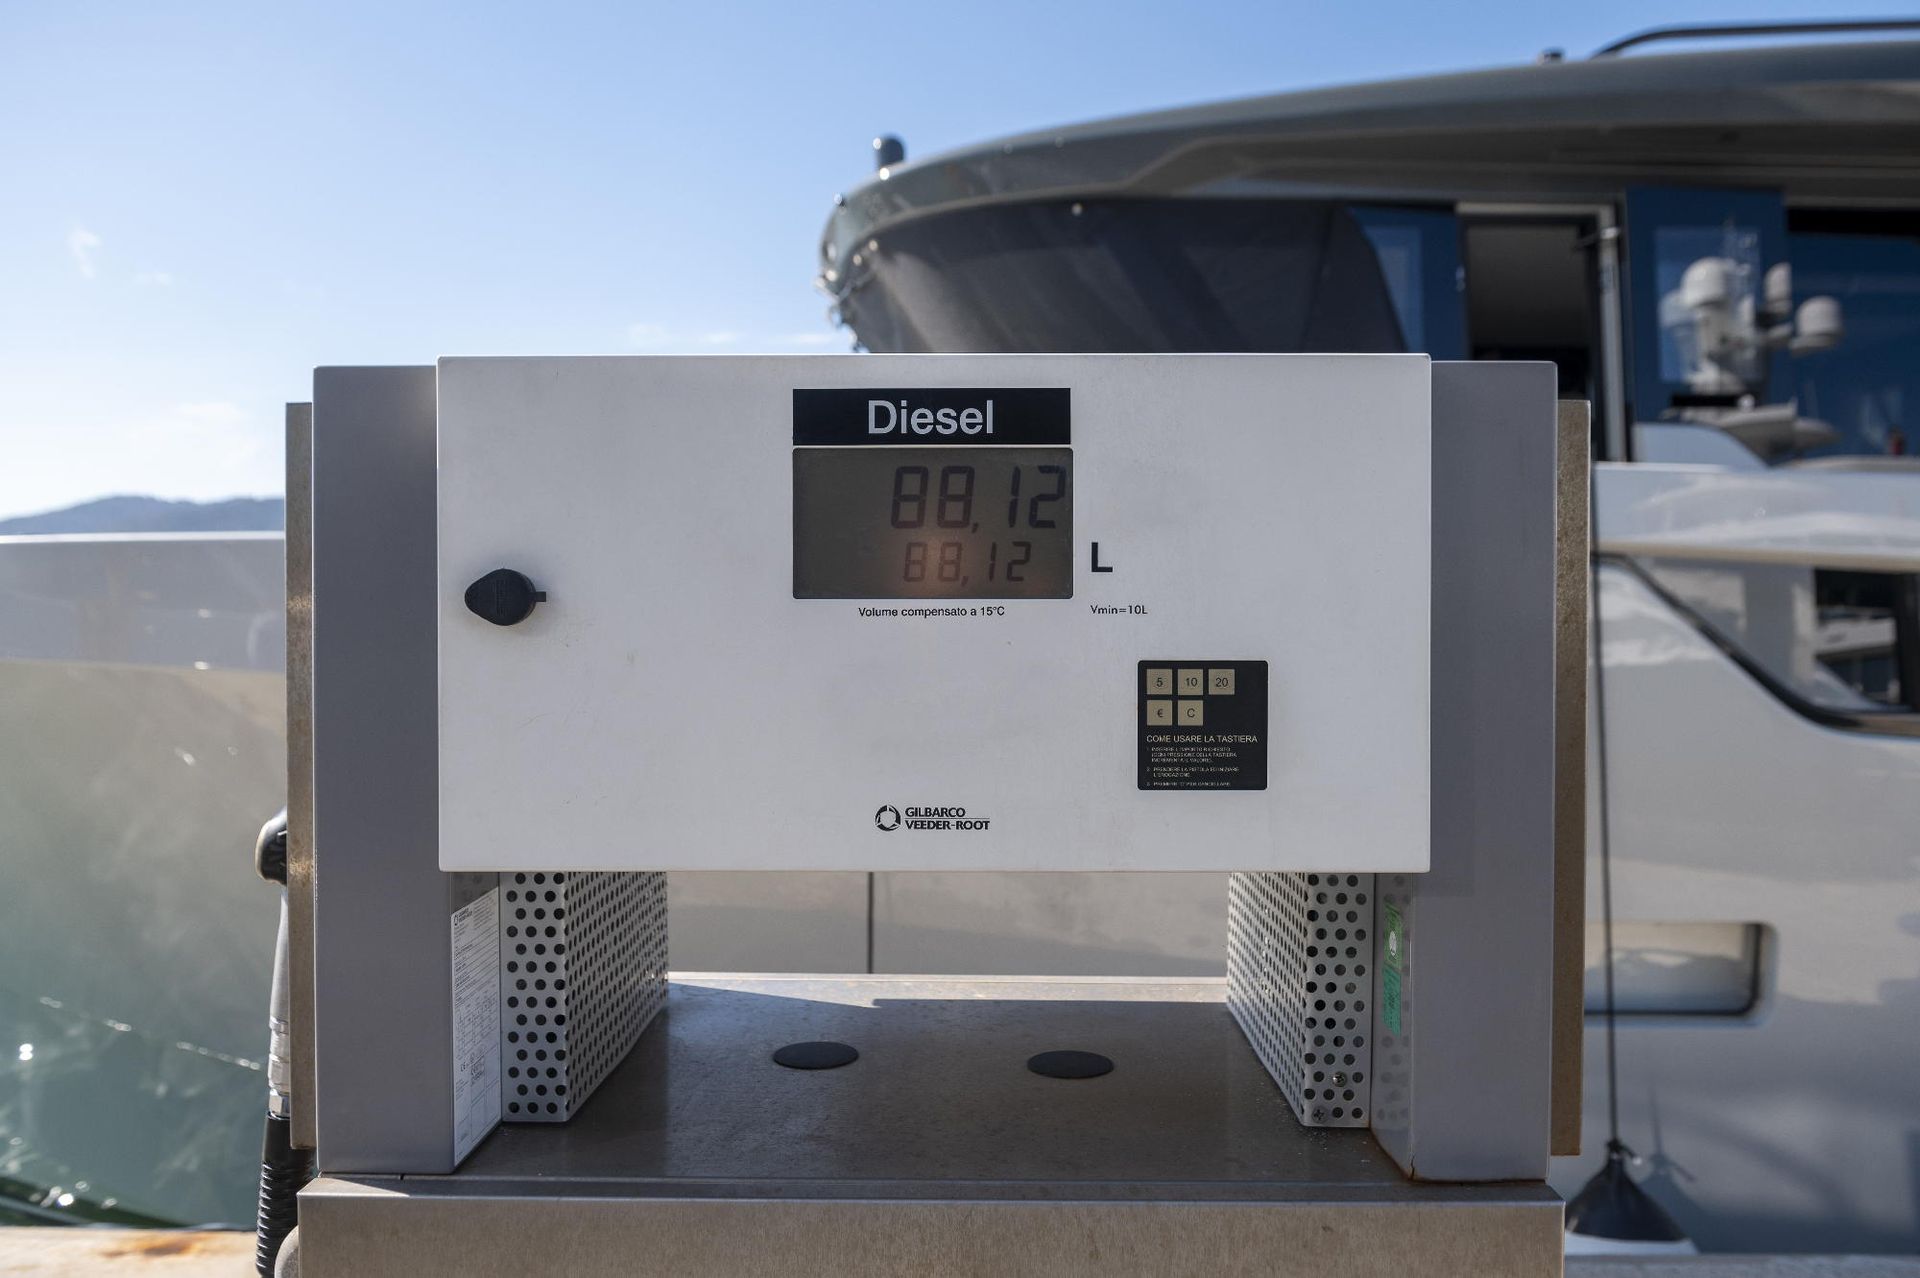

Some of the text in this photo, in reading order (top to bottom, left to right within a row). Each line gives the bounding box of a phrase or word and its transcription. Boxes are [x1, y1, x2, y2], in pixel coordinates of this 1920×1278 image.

[868, 400, 994, 435] Diesel
[890, 465, 1067, 533] 88,12
[1091, 542, 1113, 573] L
[858, 605, 1005, 619] Volume compensato a 15°C
[1090, 604, 1148, 615] Vmin=10L
[1156, 677, 1163, 687] 5
[1186, 677, 1198, 687] 10
[1215, 677, 1229, 687] 20
[1186, 708, 1196, 718] C
[1146, 734, 1258, 743] COME USARE LA TASTIERA
[904, 807, 966, 817] GILBARCO
[904, 820, 990, 830] VEEDER-ROOT
